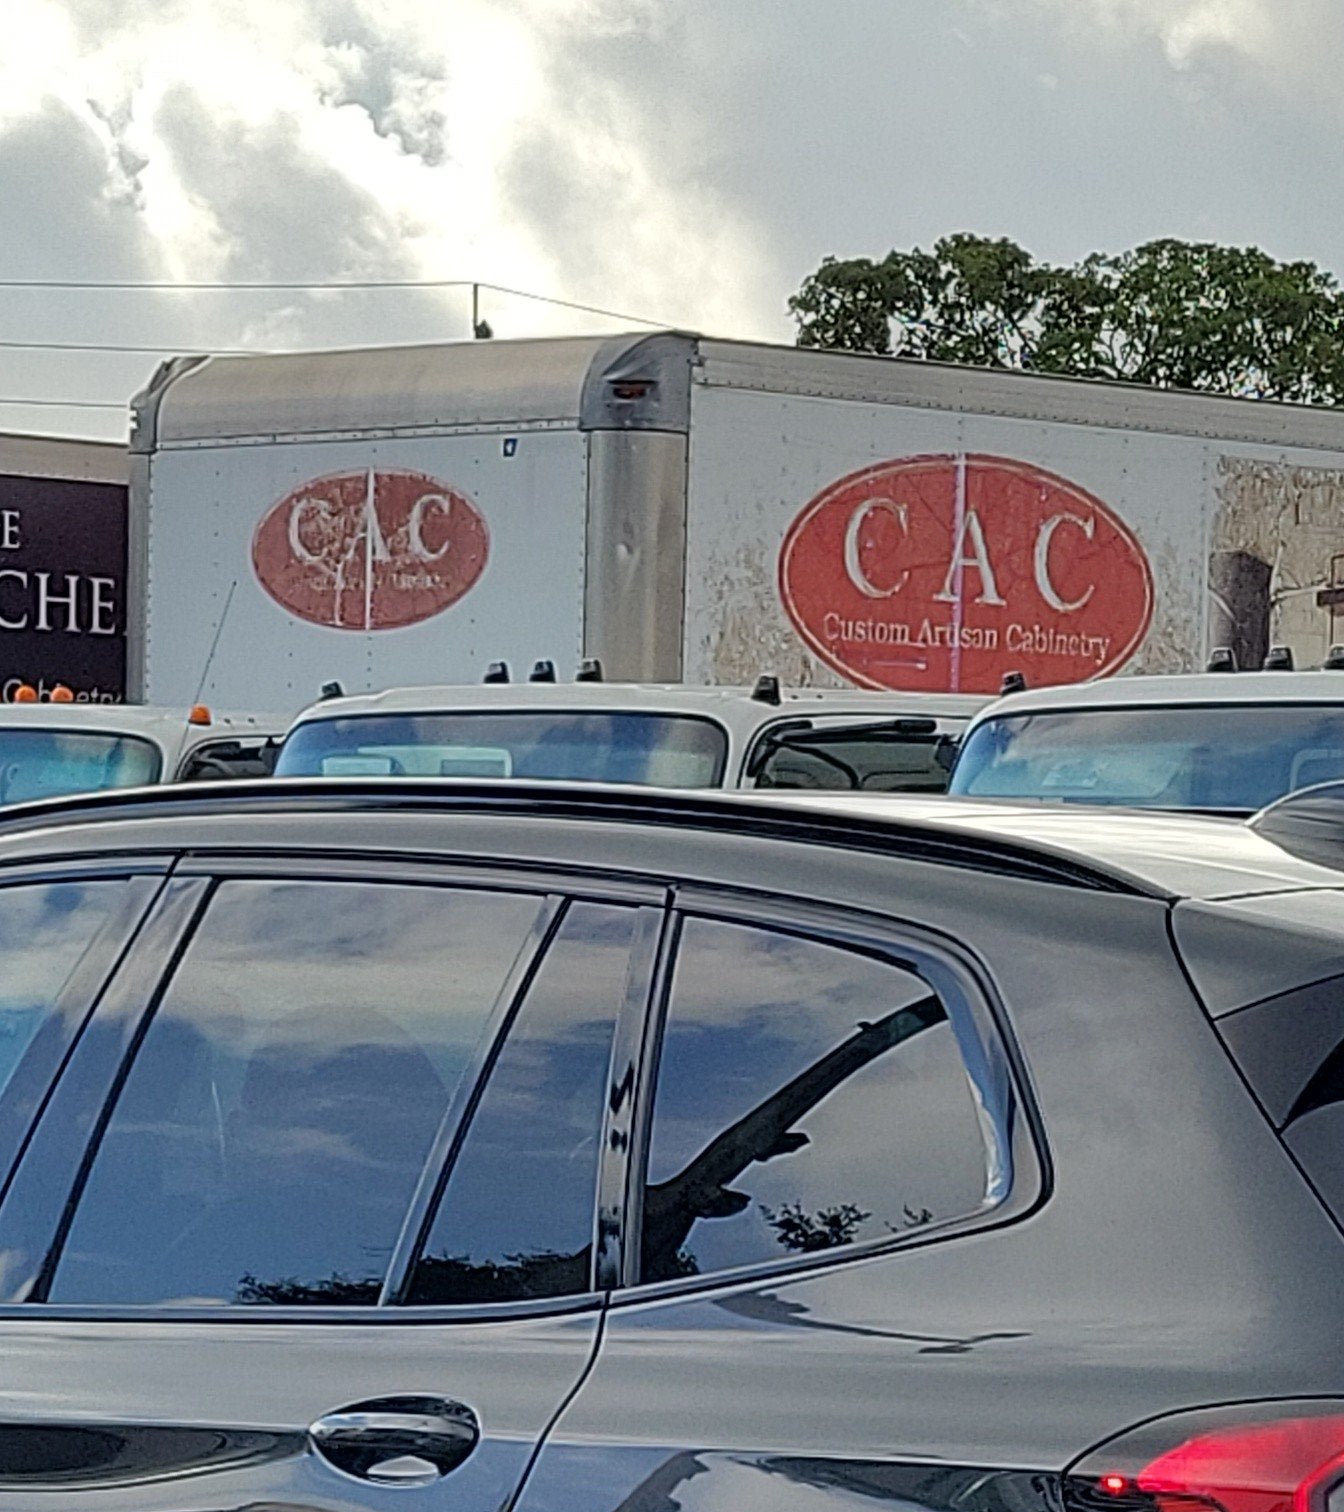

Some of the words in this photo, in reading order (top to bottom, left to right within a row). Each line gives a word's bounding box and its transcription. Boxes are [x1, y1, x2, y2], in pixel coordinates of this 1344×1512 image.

[844, 497, 1096, 613] CAC
[823, 612, 909, 645] Custom
[917, 617, 998, 650] Artisan
[1006, 623, 1110, 665] Cabinetry
